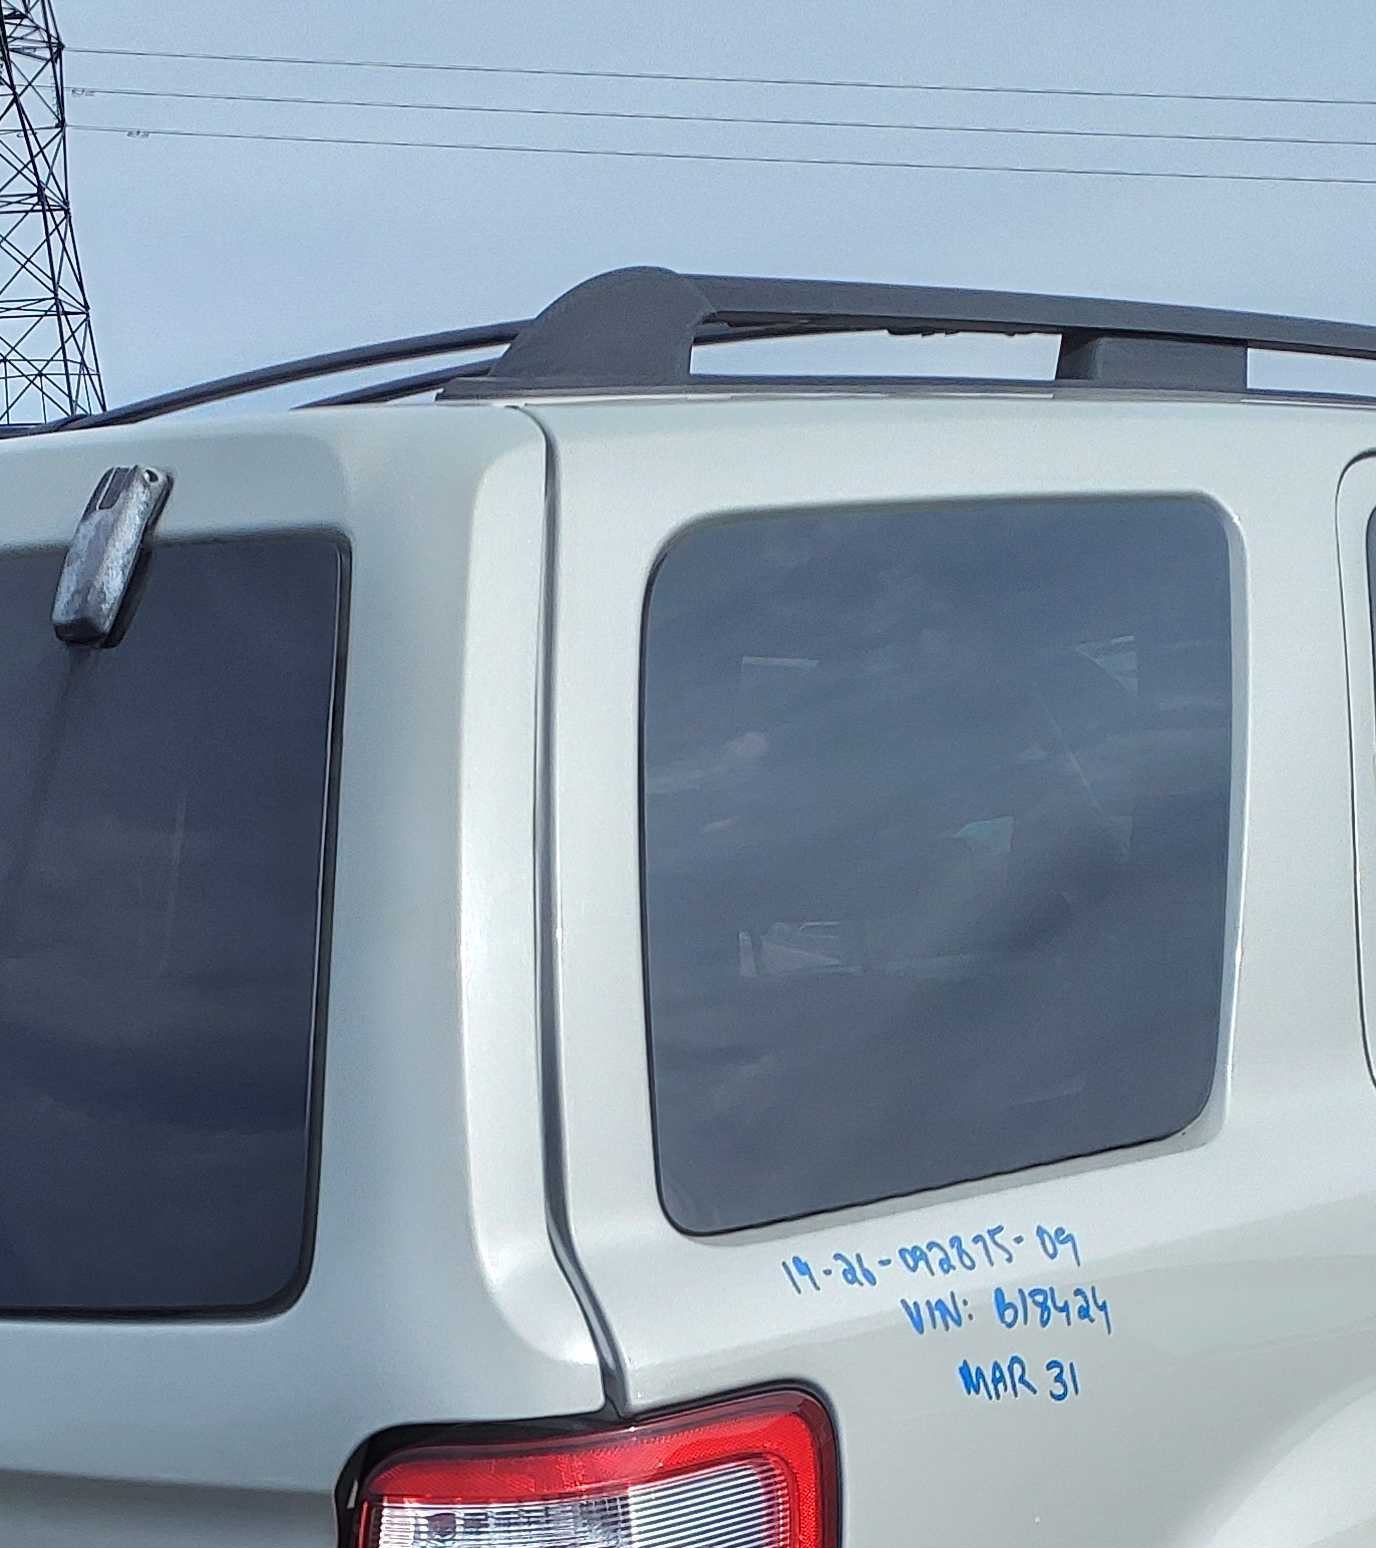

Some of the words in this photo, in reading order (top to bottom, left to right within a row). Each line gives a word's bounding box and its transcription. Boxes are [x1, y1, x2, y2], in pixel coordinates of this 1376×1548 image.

[900, 1290, 974, 1335] VIN:
[958, 1355, 1037, 1401] MAR
[1045, 1359, 1080, 1402] 31
